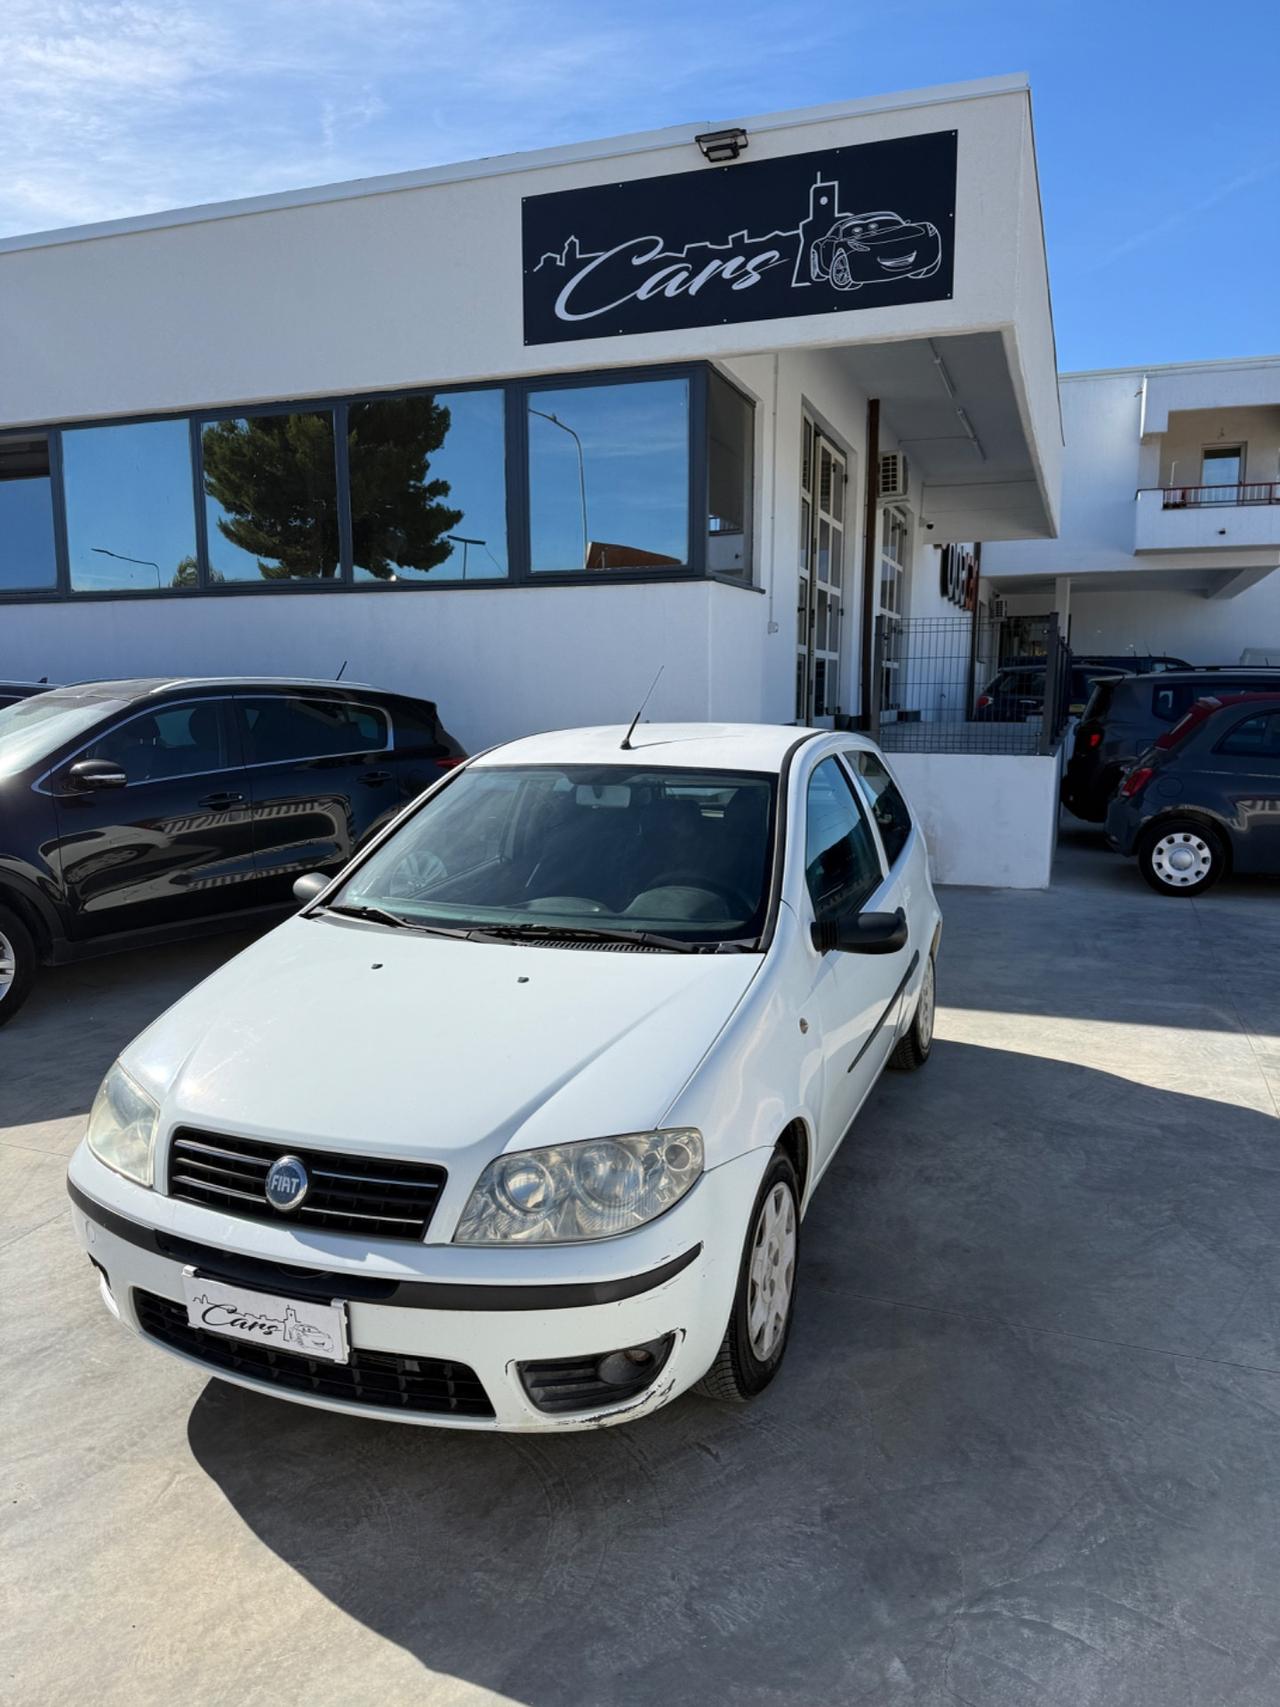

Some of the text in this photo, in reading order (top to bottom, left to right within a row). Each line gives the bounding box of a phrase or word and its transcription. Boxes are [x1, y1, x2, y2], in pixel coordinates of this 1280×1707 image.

[555, 236, 788, 321] Cars
[271, 1174, 300, 1194] FIAT
[202, 1304, 282, 1335] Cars
